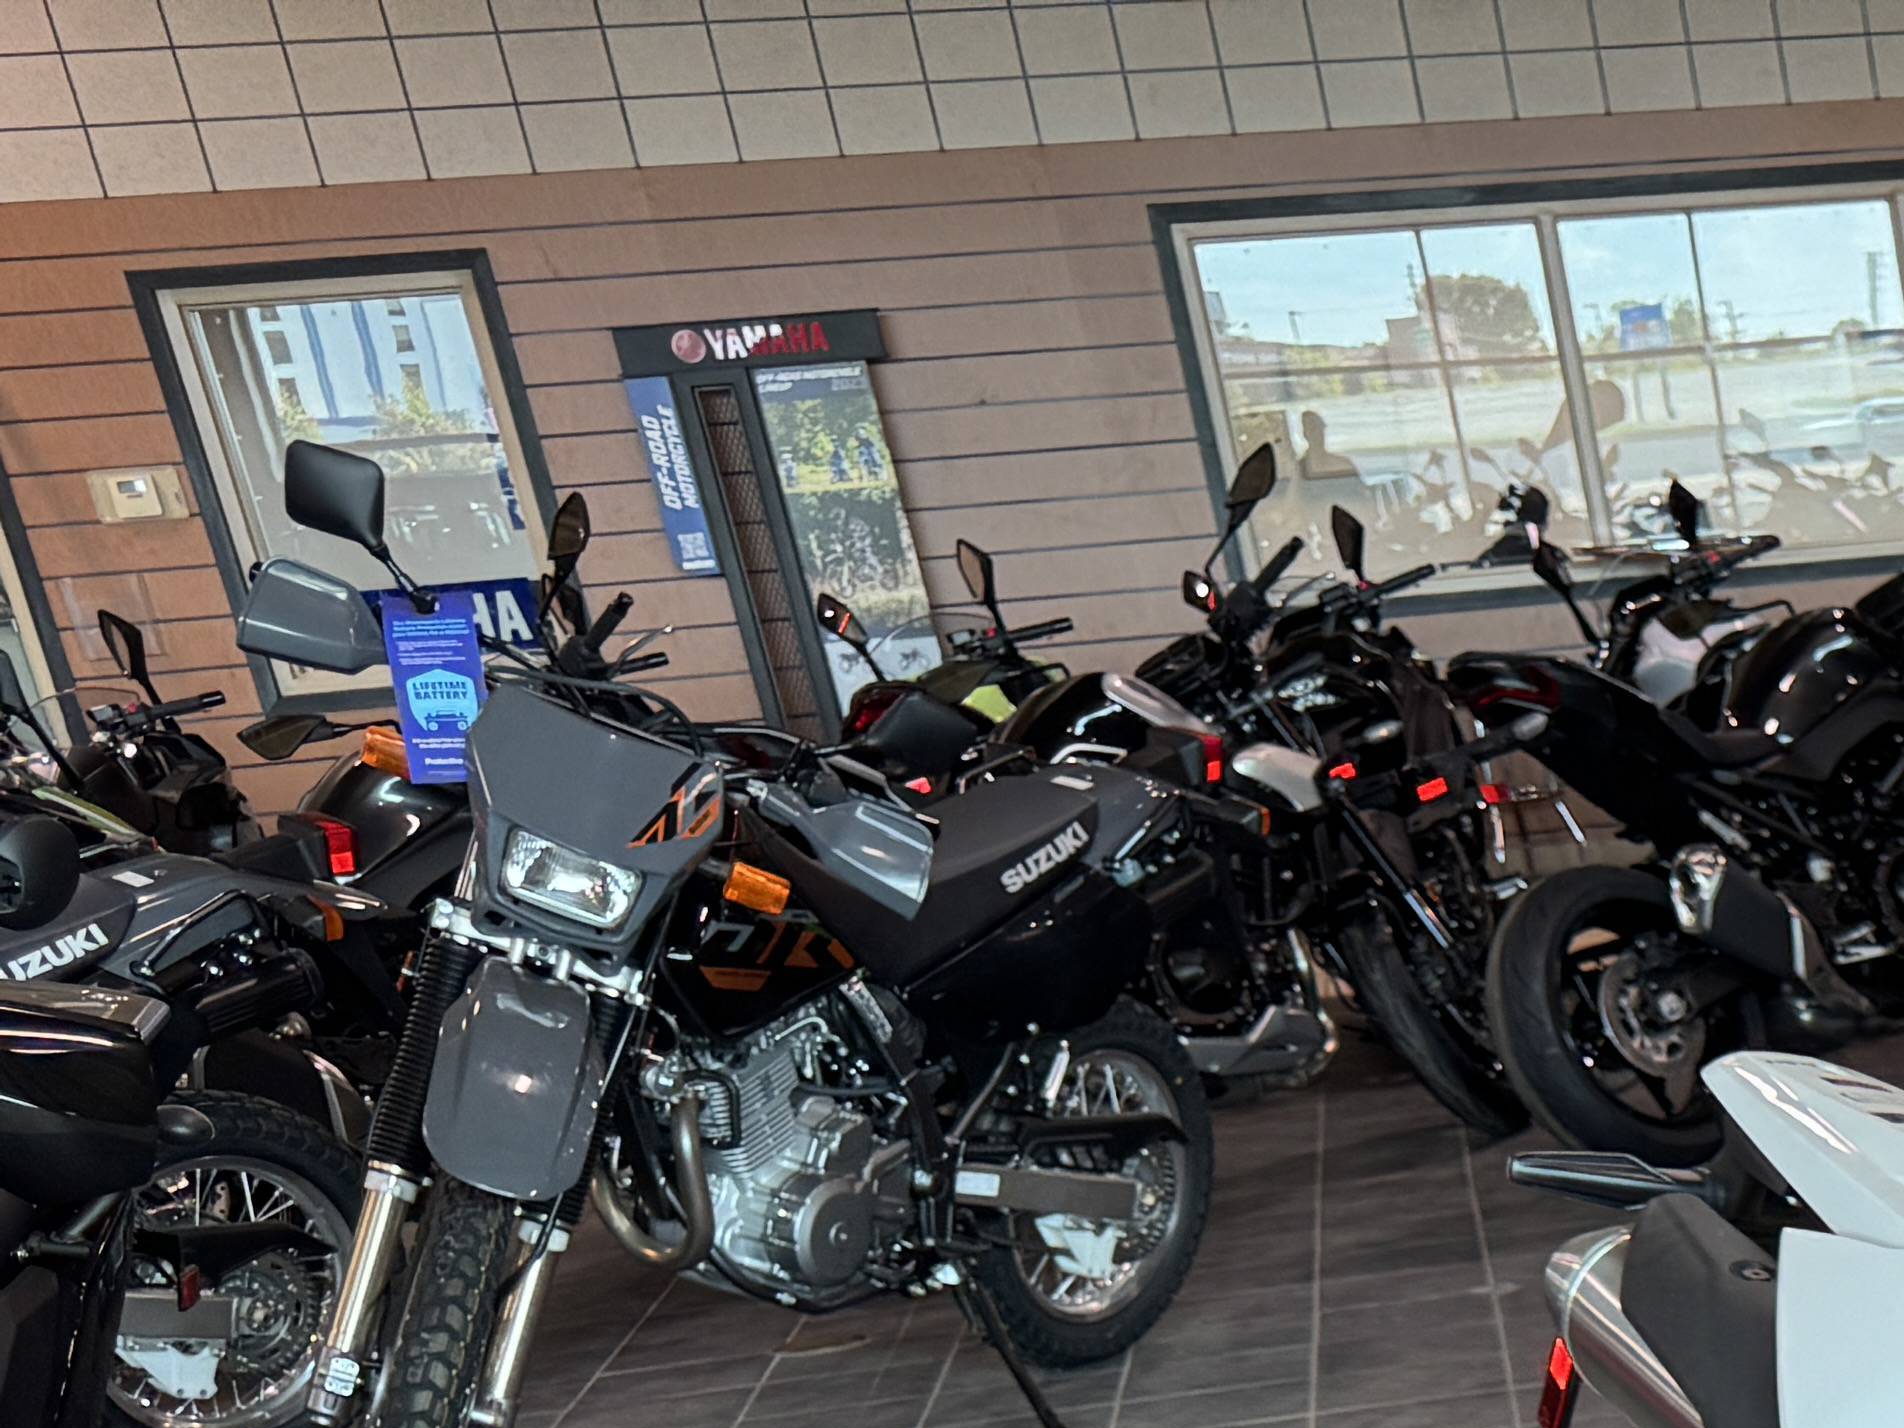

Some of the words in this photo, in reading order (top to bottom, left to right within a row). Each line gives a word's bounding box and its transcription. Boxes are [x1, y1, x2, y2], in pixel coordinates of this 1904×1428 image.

[703, 321, 831, 361] YAMAHA
[641, 414, 684, 511] OFF-ROAD
[656, 404, 700, 509] MOTORCYCLE
[414, 690, 469, 701] BATTERY
[1000, 821, 1090, 894] SUZUKI
